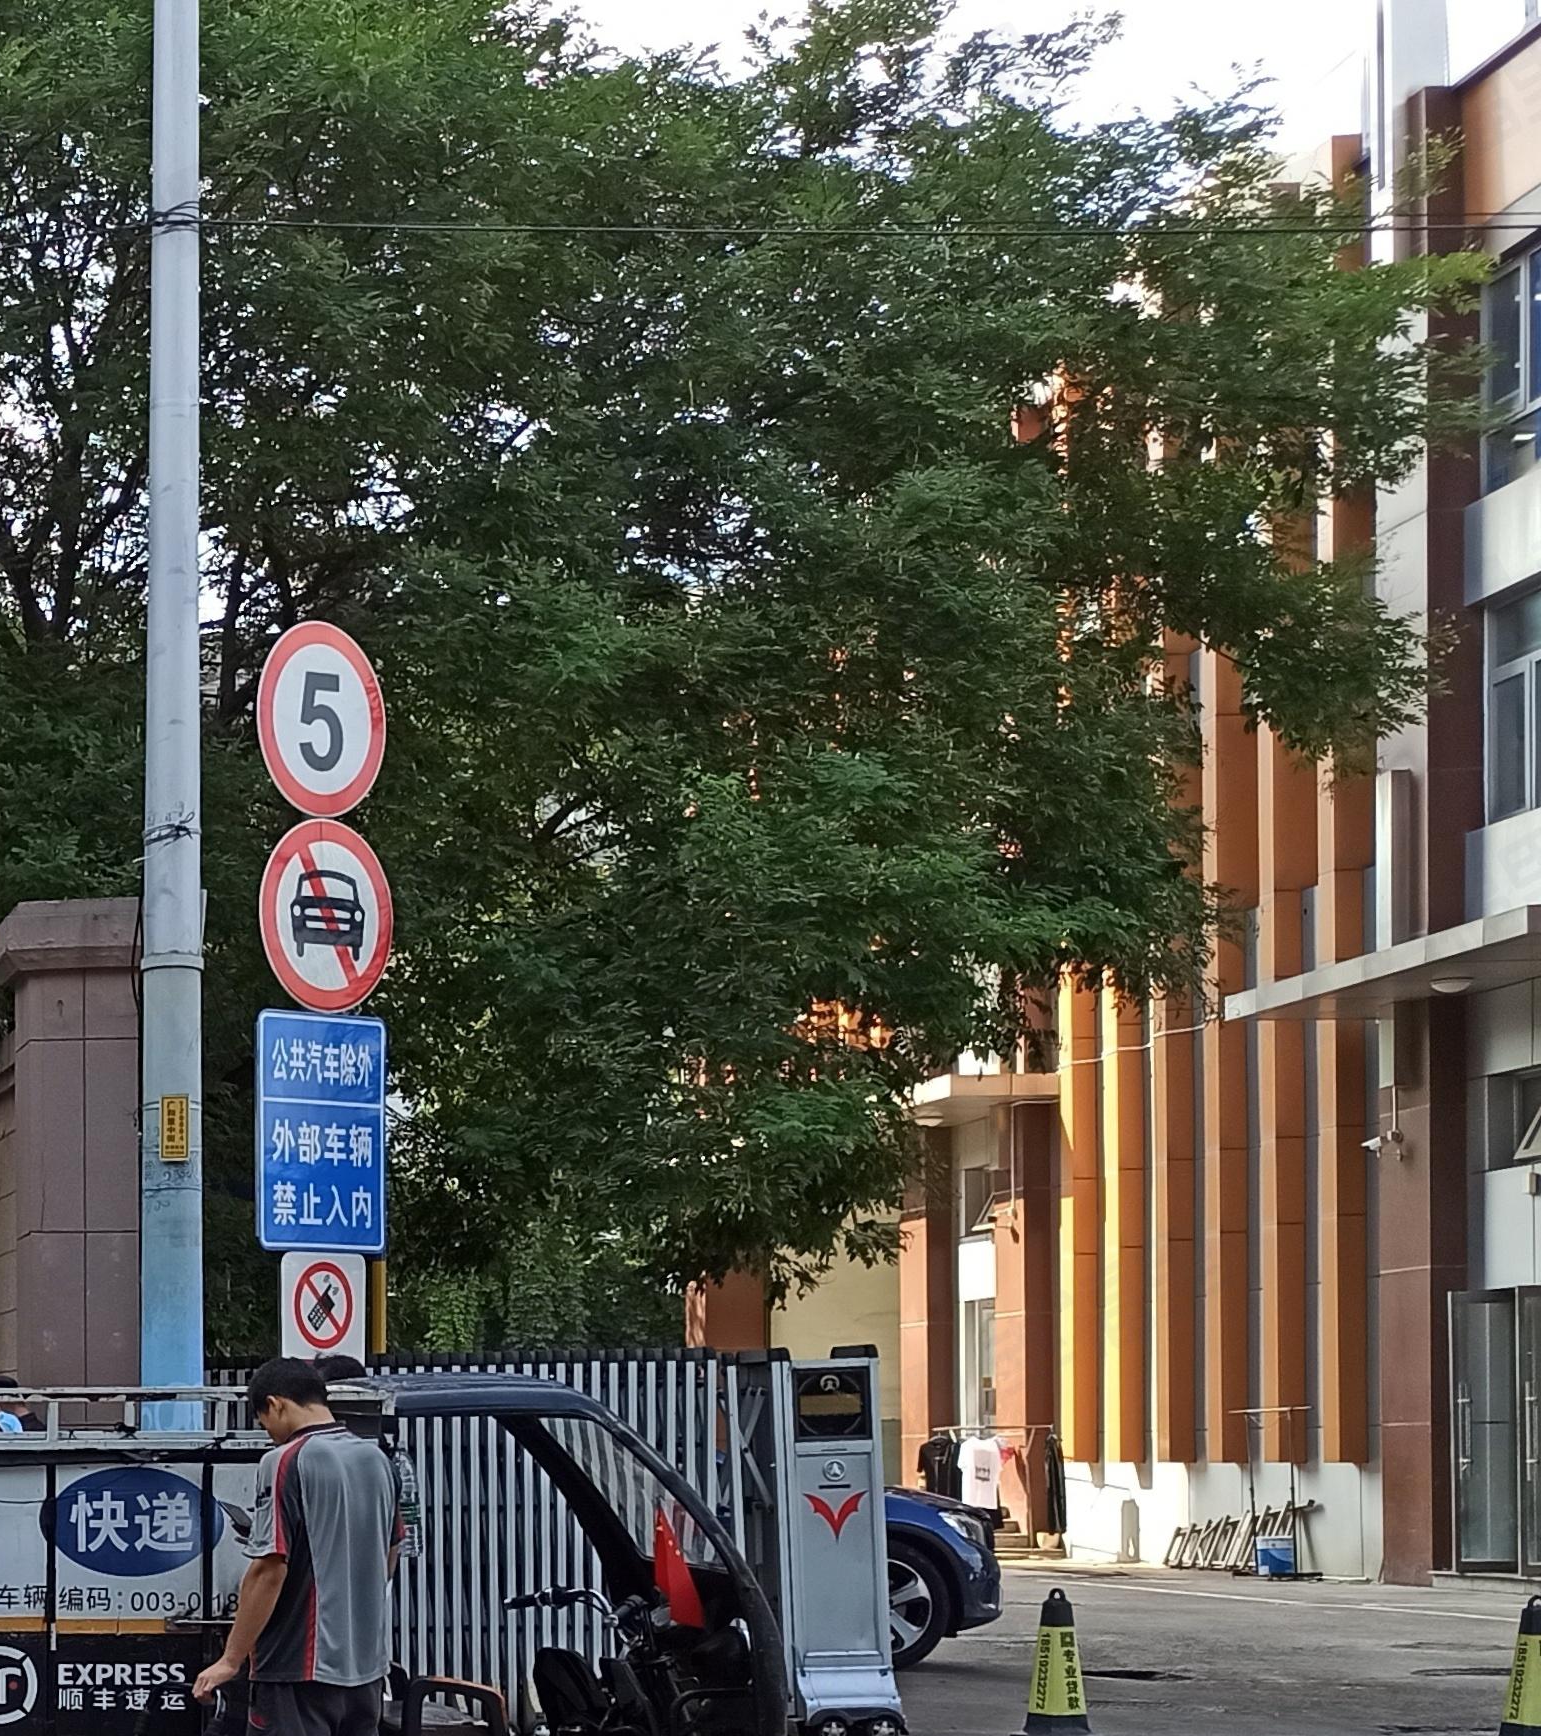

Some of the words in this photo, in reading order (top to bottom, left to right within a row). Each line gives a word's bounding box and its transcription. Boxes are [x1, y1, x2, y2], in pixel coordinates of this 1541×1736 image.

[299, 671, 344, 772] 5
[272, 1038, 373, 1088] 公共汽车除外
[272, 1119, 373, 1168] 外部车辆
[272, 1181, 372, 1229] 禁止入内
[69, 1491, 193, 1552] 快递
[57, 1663, 186, 1685] EXPRESS
[1062, 1649, 1081, 1710] 专业贷款
[58, 1687, 186, 1711] 顺丰速运
